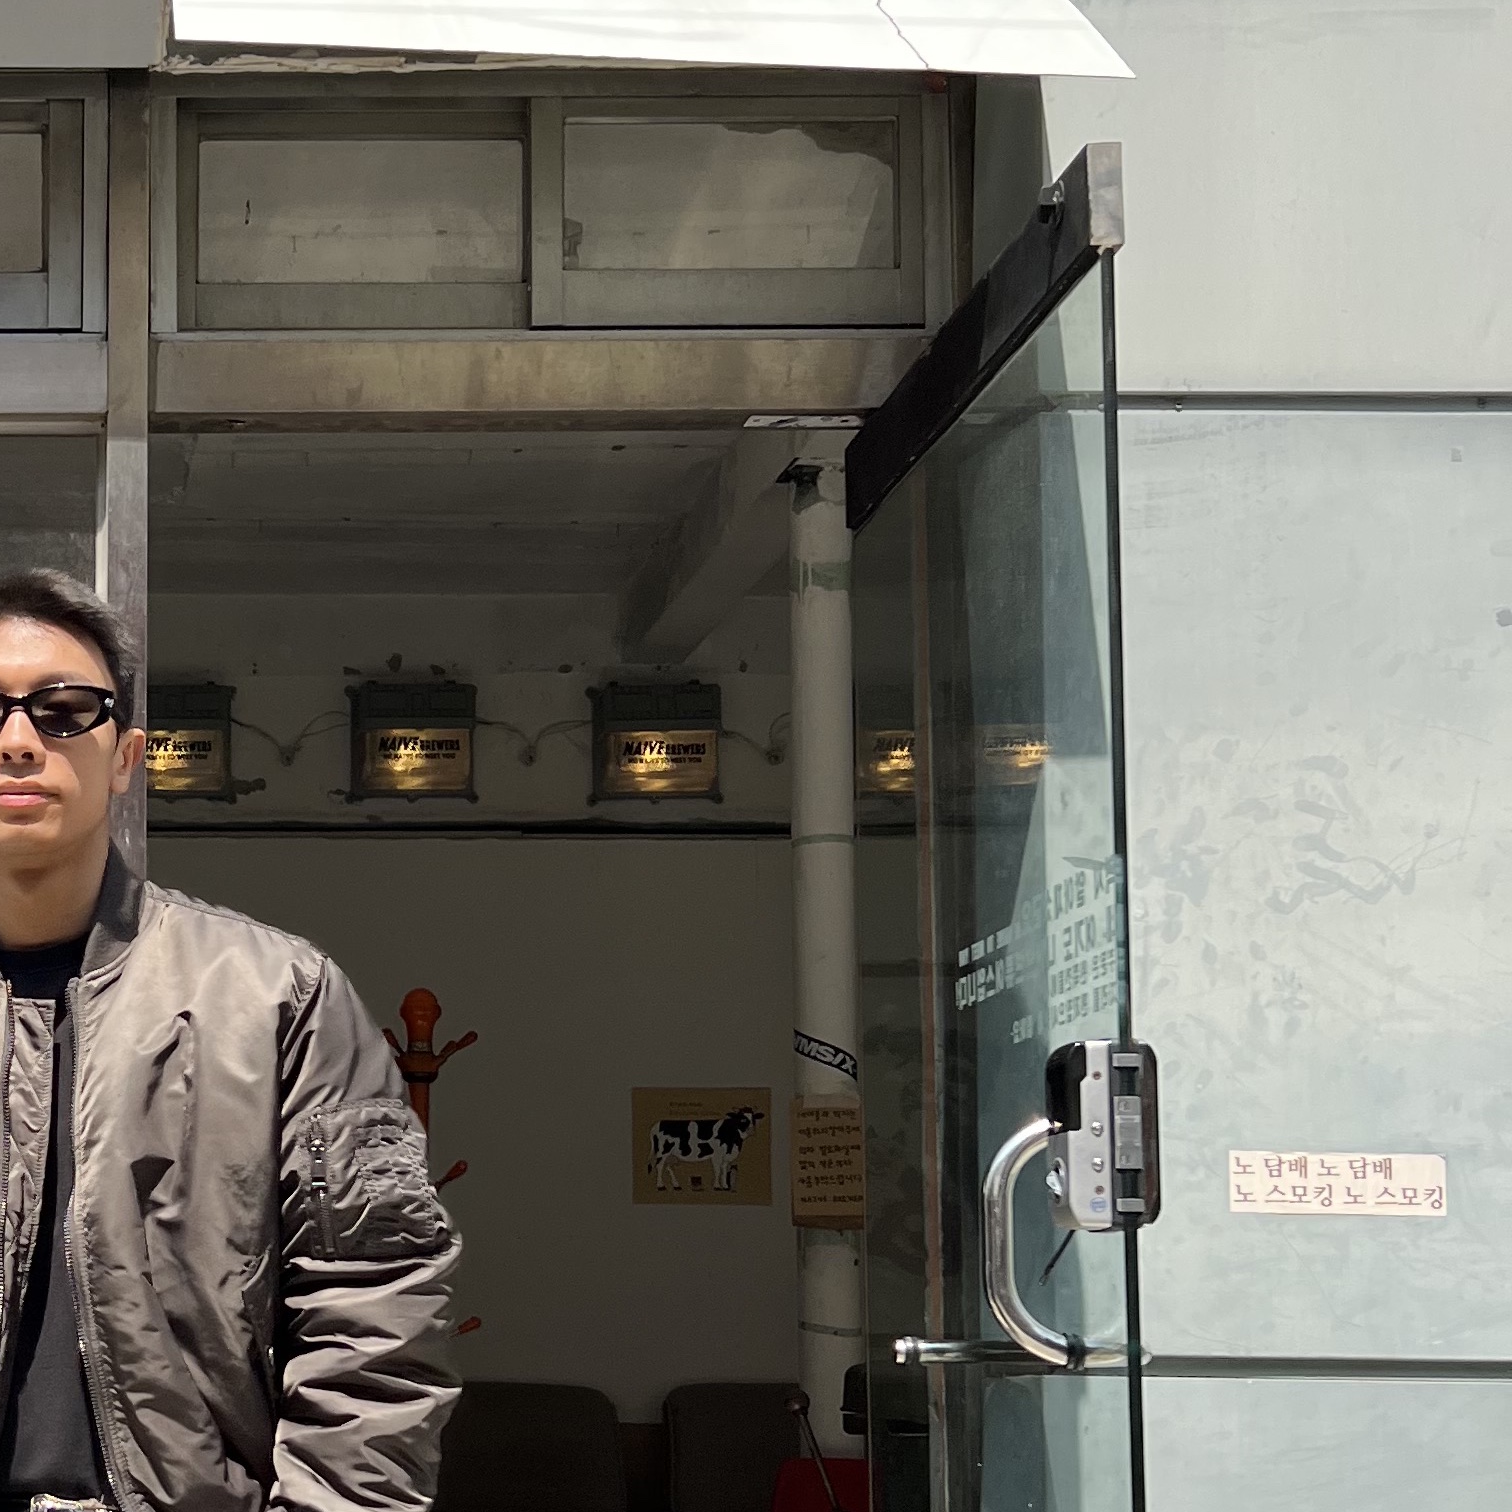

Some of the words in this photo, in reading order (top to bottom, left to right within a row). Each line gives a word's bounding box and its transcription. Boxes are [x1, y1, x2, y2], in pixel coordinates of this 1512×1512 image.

[1232, 1156, 1256, 1175] 노
[1264, 1155, 1308, 1179] 담배
[1317, 1158, 1341, 1177] 노
[1348, 1156, 1393, 1180] 담배
[1233, 1184, 1257, 1204] 노
[1264, 1183, 1333, 1208] 스모킹
[1343, 1186, 1367, 1205] 노
[1374, 1185, 1444, 1210] 스모킹
